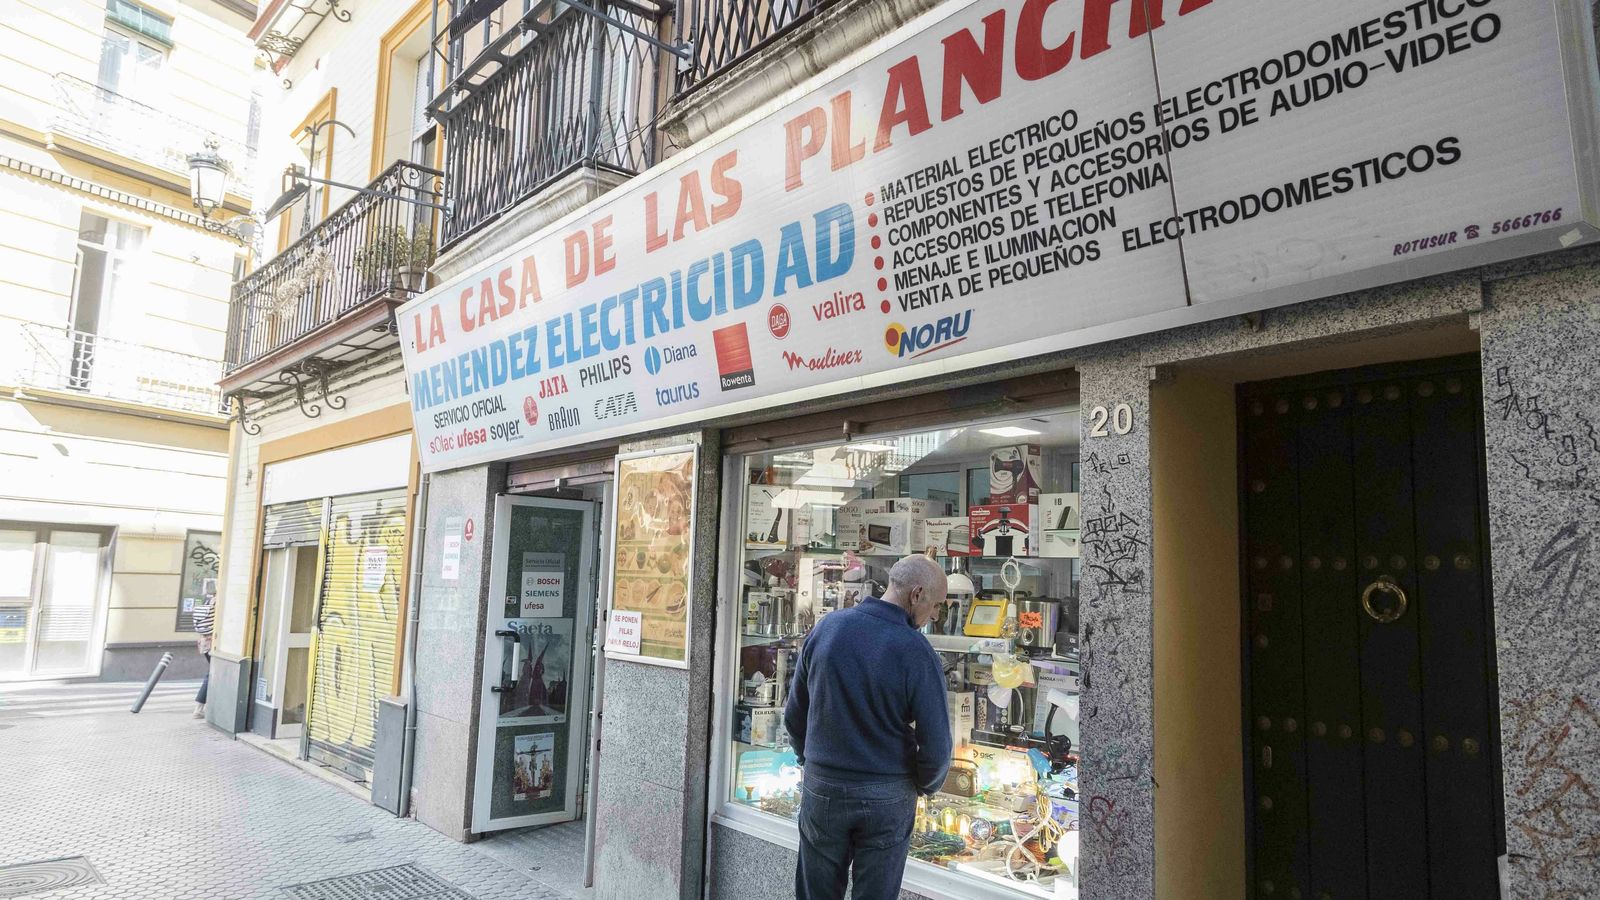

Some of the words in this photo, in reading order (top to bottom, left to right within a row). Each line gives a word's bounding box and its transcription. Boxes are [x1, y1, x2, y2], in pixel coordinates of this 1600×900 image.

[884, 172, 985, 226] REPUESTOS
[990, 159, 1018, 187] DE
[1022, 111, 1146, 174] PEQUEÑOS
[1153, 0, 1492, 127] ELECTRODOMESTIC
[887, 184, 1023, 247] COMPONENTES
[1027, 176, 1041, 198] Y
[1050, 118, 1209, 193] ACCESORIOS
[1218, 98, 1259, 134] DE
[1269, 13, 1502, 117] AUDIO-VIDEO
[880, 155, 964, 204] MATERIAL
[967, 108, 1078, 176] ELECTRICO
[892, 215, 1005, 269] ACCESORIOS
[1010, 204, 1039, 231] DE
[1043, 162, 1169, 219] TELEFONIA
[897, 284, 954, 313] VENTA
[958, 273, 984, 297] DE
[988, 240, 1101, 289] PEQUEÑOS
[1122, 136, 1461, 253] ELECTRODOMESTICOS
[1393, 231, 1458, 256] ROTUSUR
[1491, 207, 1562, 235] 5666766
[414, 304, 446, 354] LA
[460, 254, 542, 333] CASA
[563, 214, 617, 289] DE
[643, 149, 743, 254] LAS
[894, 253, 962, 291] MENAJE
[968, 249, 980, 270] E
[984, 206, 1117, 265] ILUMINACION
[414, 325, 541, 412] MENENDEZ
[546, 202, 856, 369] ELECTRICIDAD
[771, 312, 788, 328] DAGA
[812, 290, 866, 321] valira
[898, 309, 971, 357] NORU
[663, 343, 697, 364] Diana
[782, 347, 863, 371] Moulinex
[579, 354, 632, 388] PHILIPS
[721, 373, 752, 387] Rowenta
[538, 374, 568, 399] JATA
[655, 381, 700, 407] taurus
[433, 404, 470, 429] SERVICIO
[471, 394, 506, 418] OFICIAL
[548, 406, 581, 431] BRAUN
[594, 391, 638, 420] CATA
[1089, 403, 1133, 438] 20
[456, 427, 487, 449] ufesa
[839, 506, 859, 514] SOGO
[524, 602, 545, 610] ufesa
[614, 614, 621, 622] SE
[621, 616, 639, 624] PONEN
[507, 620, 553, 635] Saeta
[618, 627, 633, 636] PILAS
[622, 640, 640, 649] RELOJ
